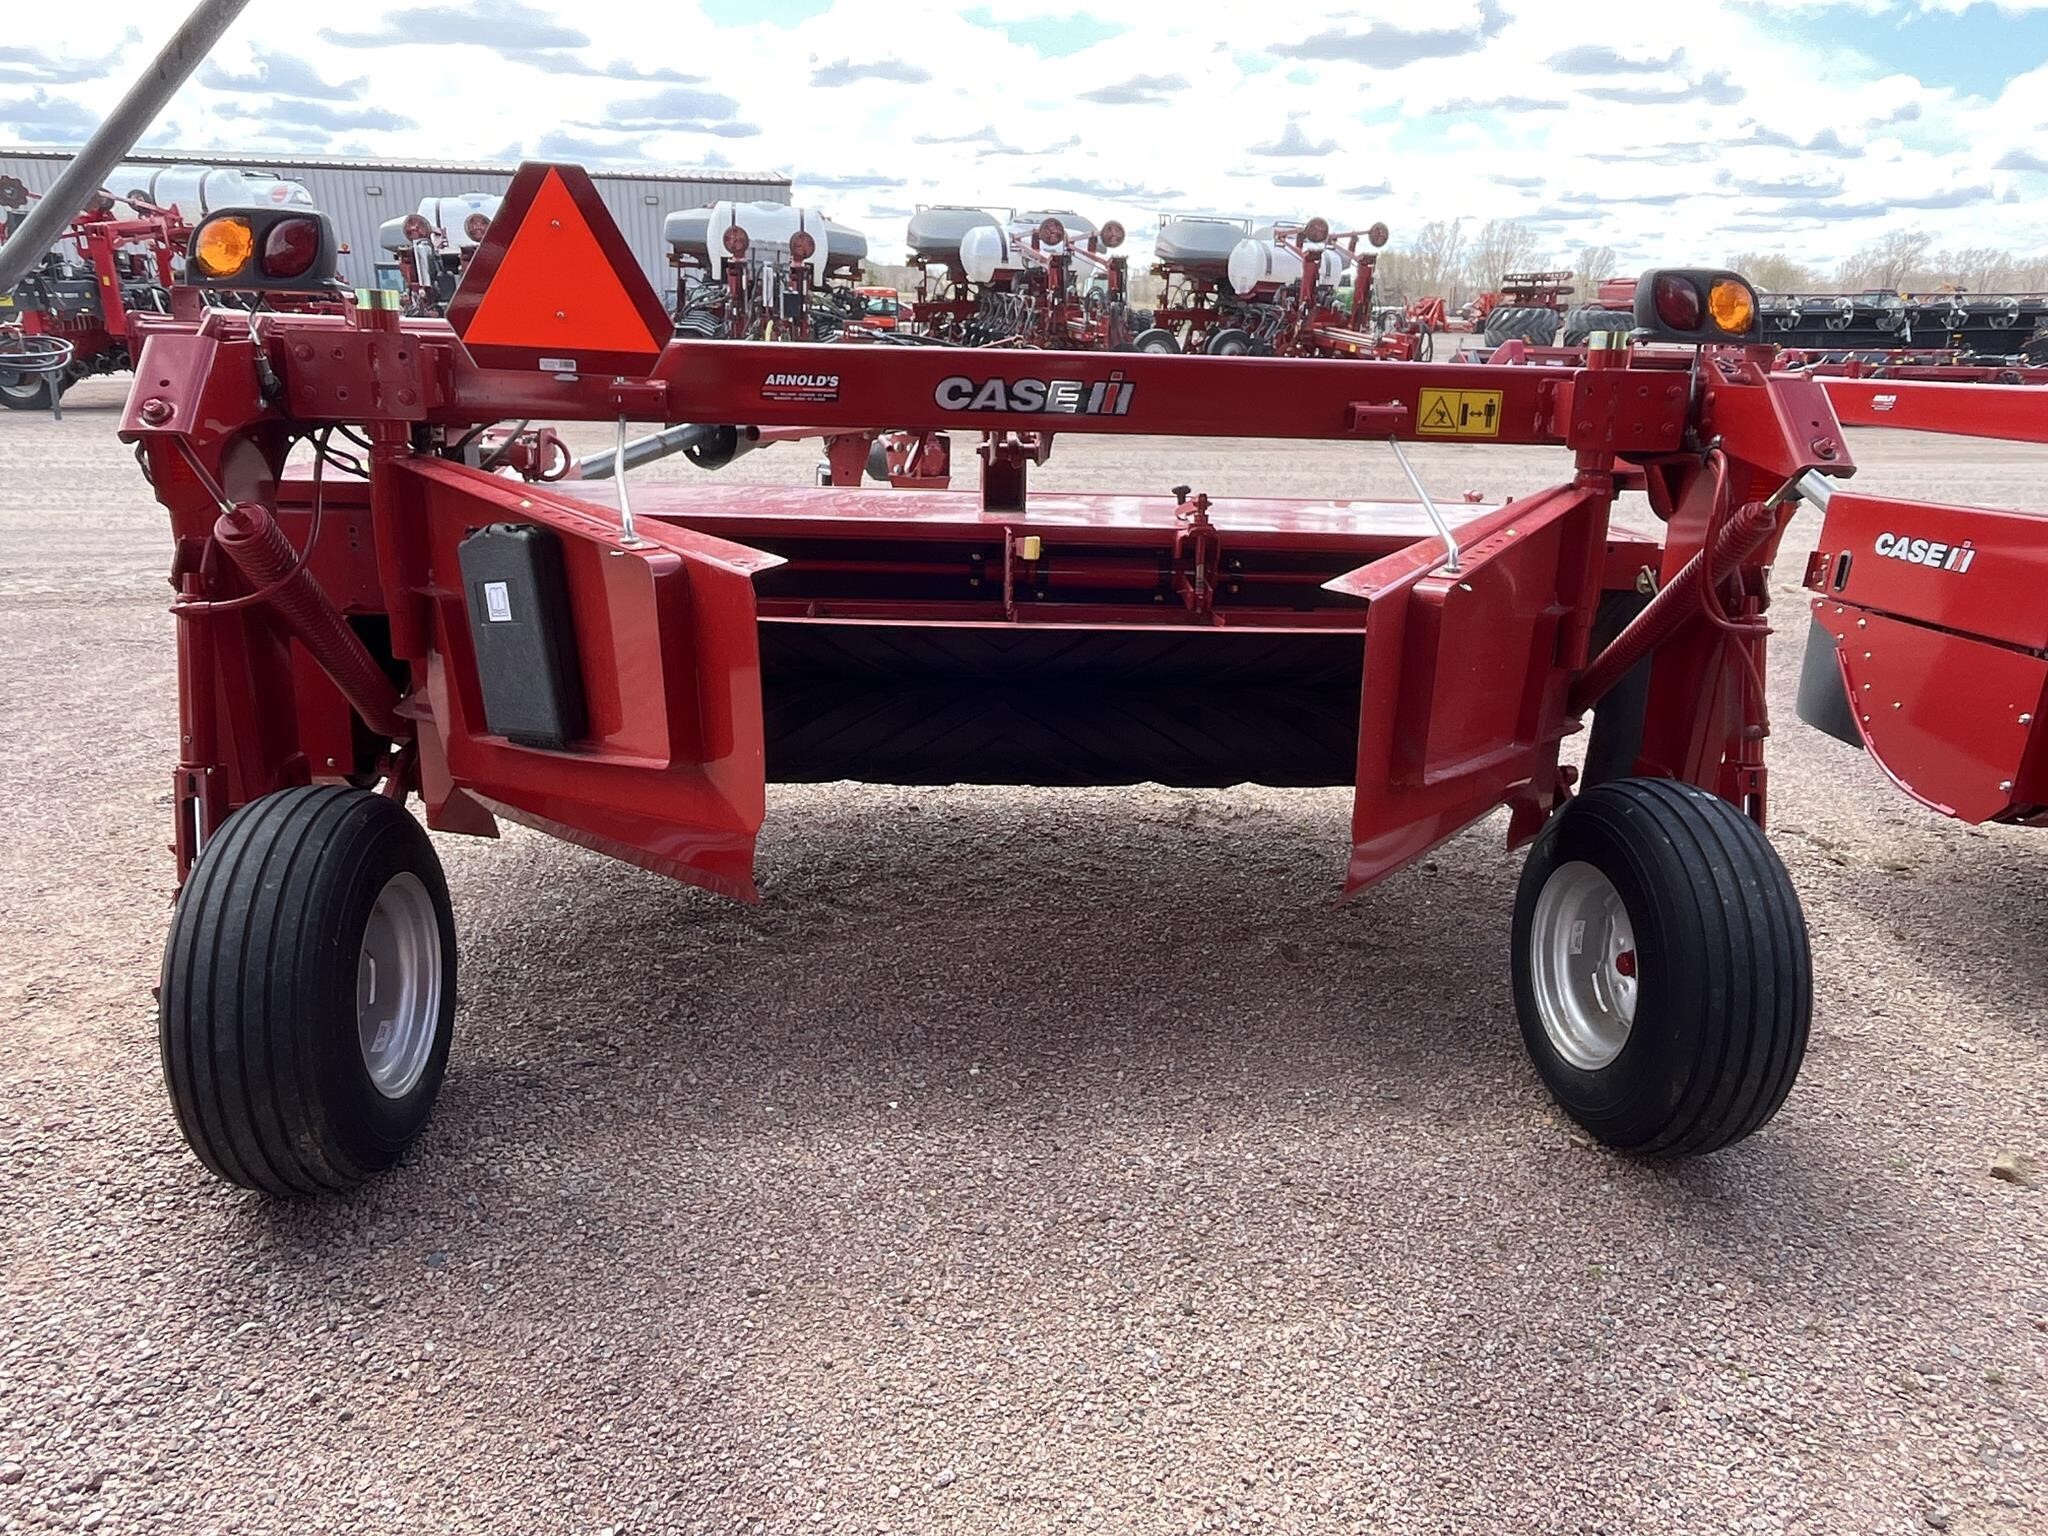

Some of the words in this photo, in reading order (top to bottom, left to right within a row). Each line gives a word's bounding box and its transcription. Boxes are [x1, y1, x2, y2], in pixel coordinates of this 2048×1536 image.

[764, 374, 839, 387] ARNOLD'S
[934, 376, 1083, 413] CASE
[1874, 532, 1948, 568] CASE
